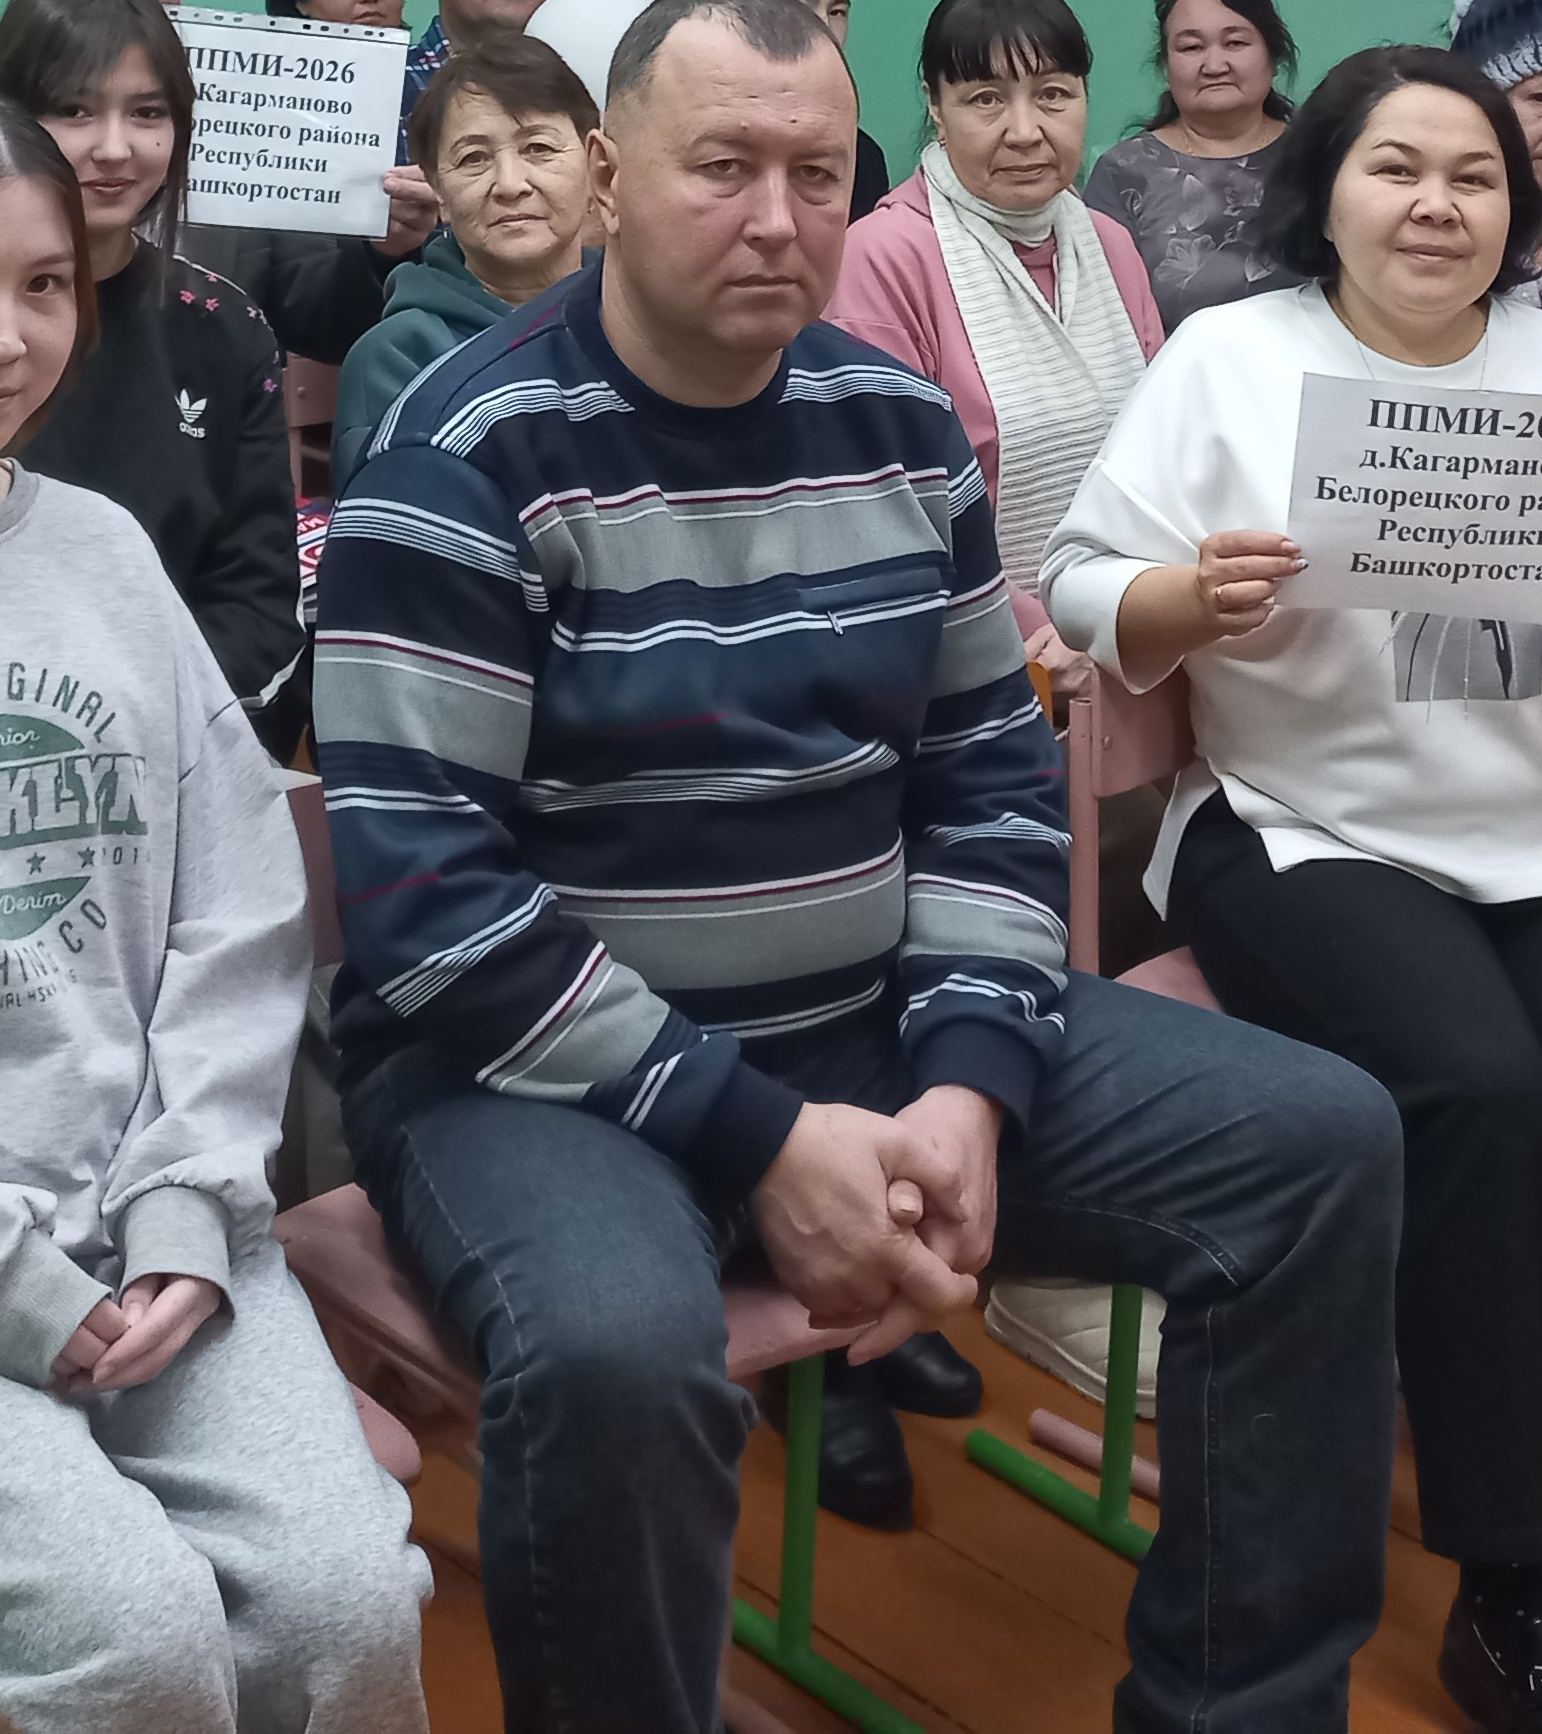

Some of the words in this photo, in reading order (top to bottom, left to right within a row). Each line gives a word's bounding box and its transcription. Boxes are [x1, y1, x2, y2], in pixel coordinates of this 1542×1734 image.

[184, 46, 356, 84] ППМИ-2026
[197, 82, 353, 115] Кагарманово
[191, 117, 292, 140] рецкого
[298, 125, 381, 148] района
[190, 143, 328, 173] Республики
[187, 178, 341, 204] ашкортостан
[1314, 475, 1510, 512] Белорецкого
[0, 891, 68, 914] Denim
